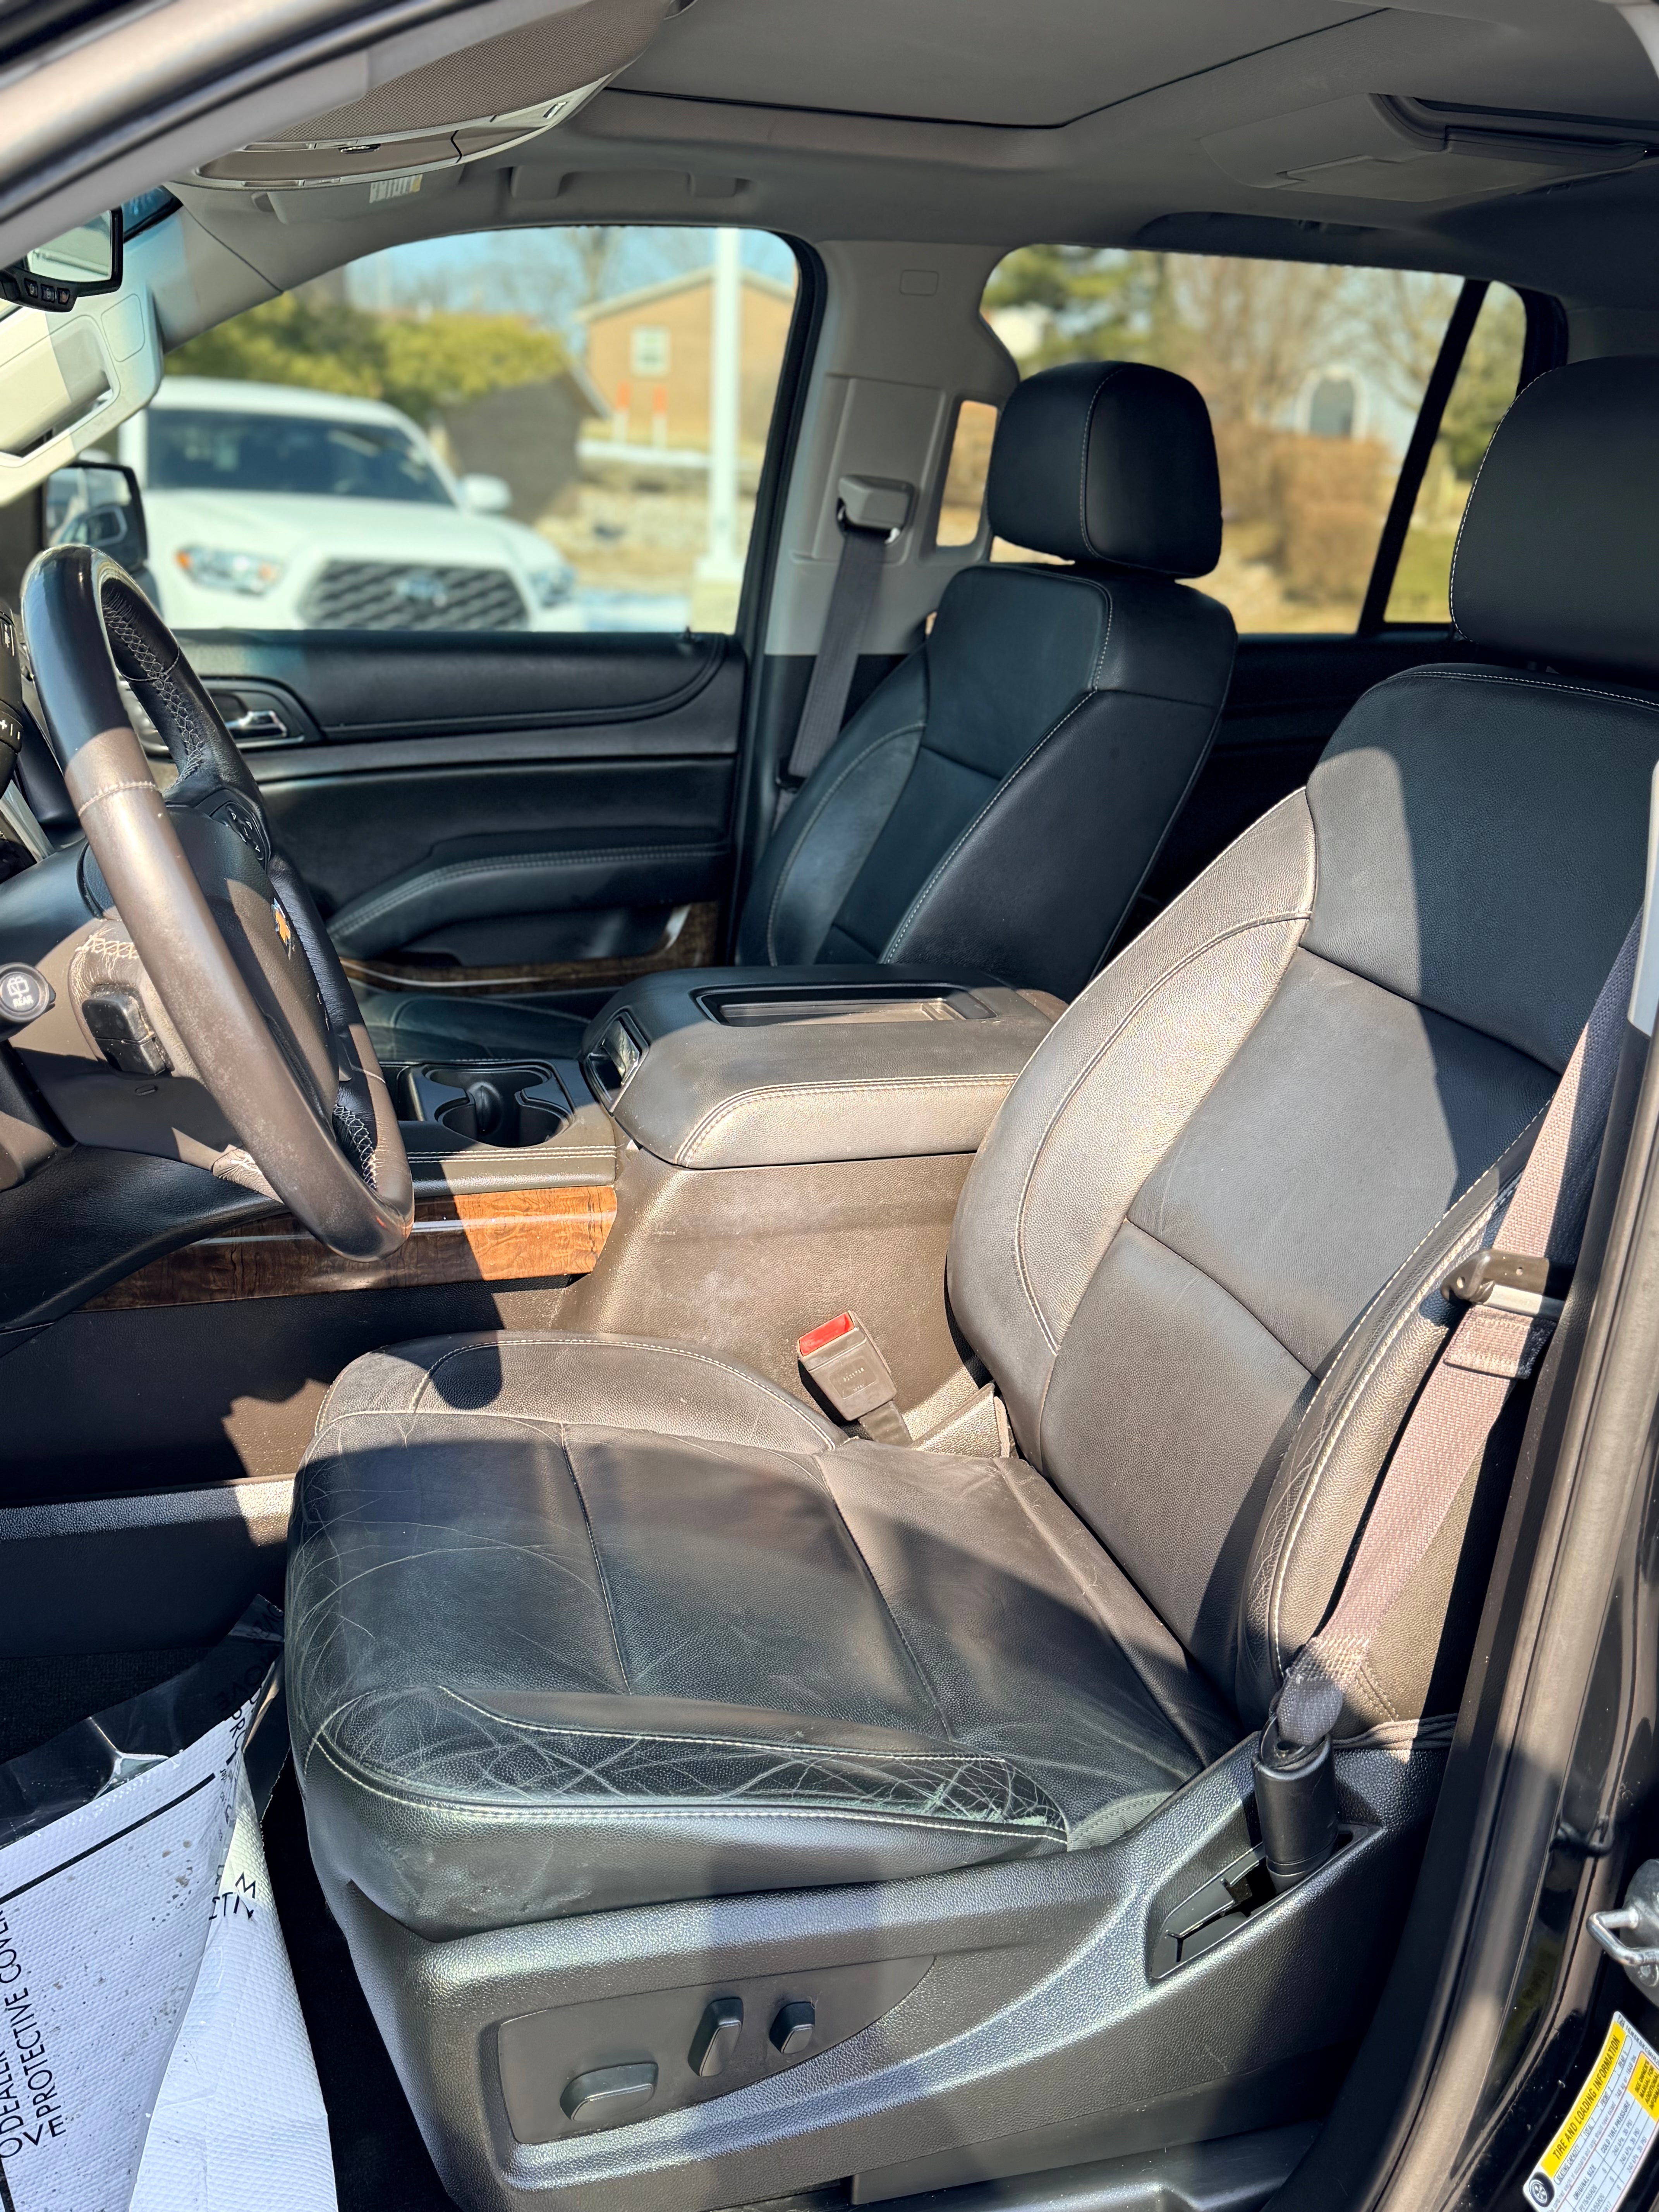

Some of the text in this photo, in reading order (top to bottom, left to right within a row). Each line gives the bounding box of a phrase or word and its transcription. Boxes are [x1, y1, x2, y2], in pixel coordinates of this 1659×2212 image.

[12, 995, 34, 1008] REAR
[5, 1987, 62, 2118] PROTECTIVE
[1553, 2034, 1620, 2160] TIRE AND LOADING INFORMATION
[1600, 2092, 1609, 2106] FRONT
[1639, 2077, 1650, 2099] MANUAL
[1583, 2123, 1593, 2137] TOTAL
[1601, 2100, 1630, 2154] COLD TIRE PRESSURE
[1556, 2143, 1580, 2183] SEATING CAPACITY
[1573, 2164, 1596, 2200] ORIGINAL SIZE
